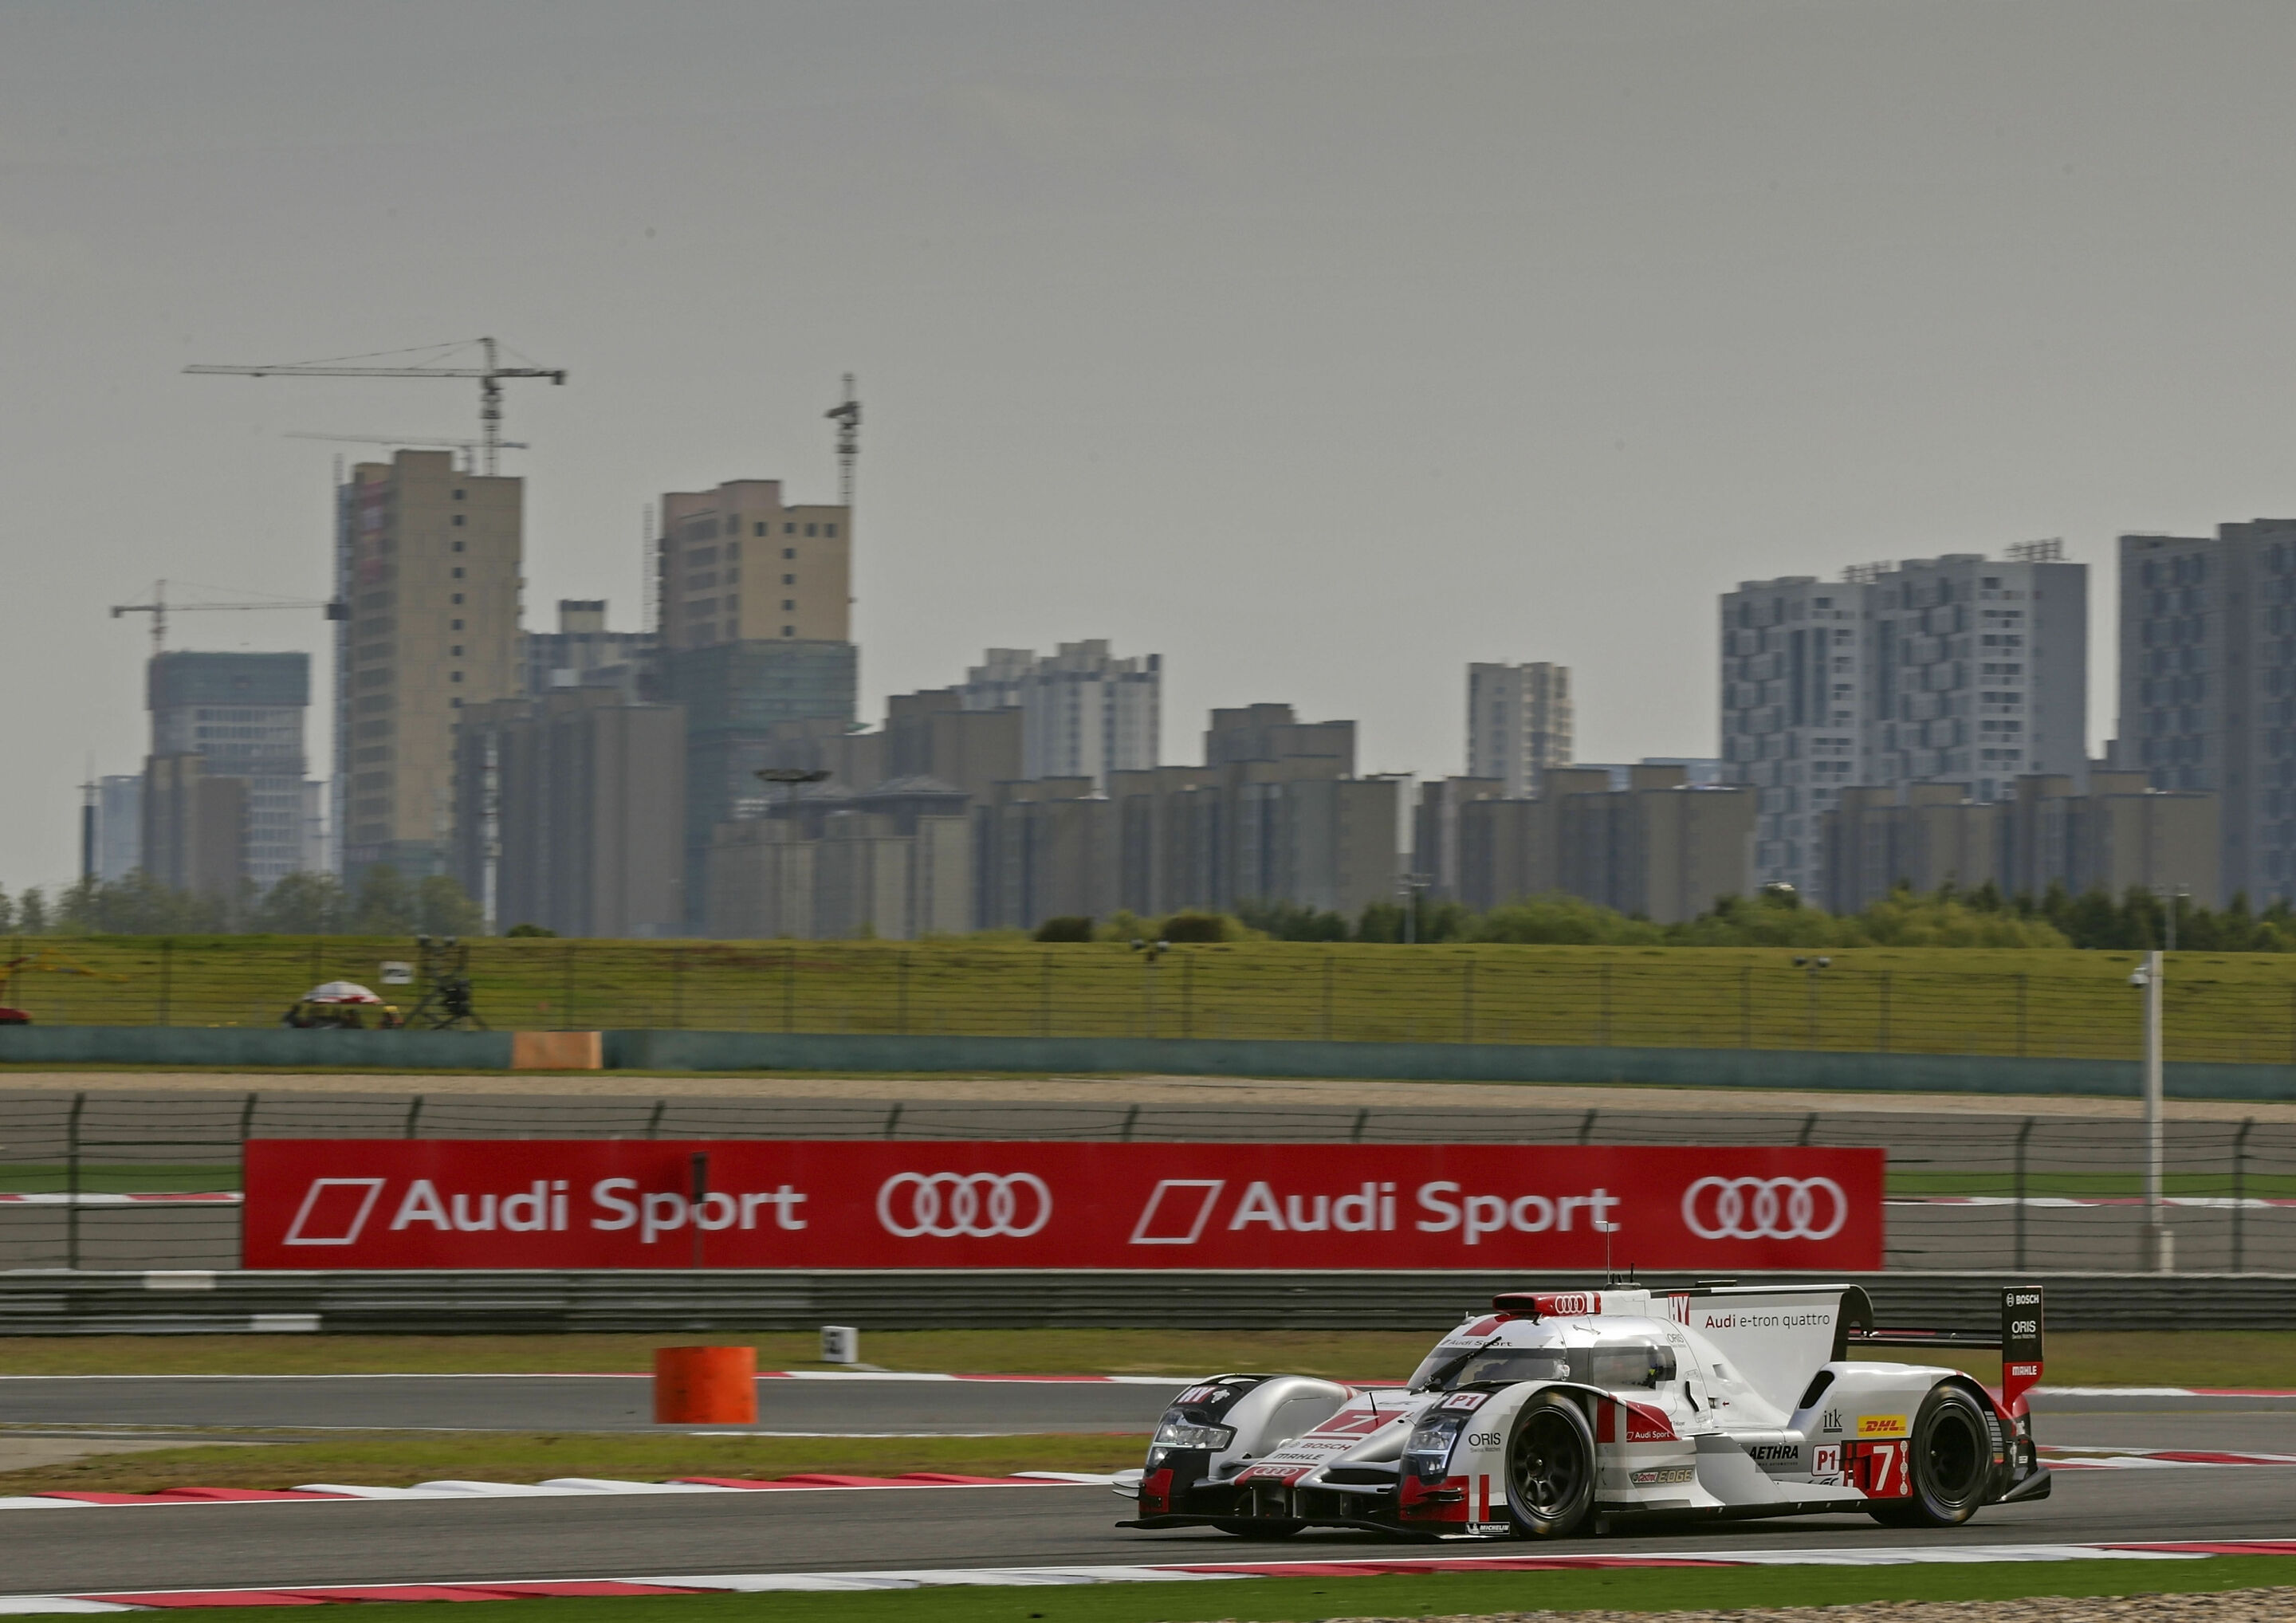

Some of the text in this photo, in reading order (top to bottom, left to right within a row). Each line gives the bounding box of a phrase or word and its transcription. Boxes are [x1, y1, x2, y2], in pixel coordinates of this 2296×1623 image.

[389, 1177, 808, 1244] Audi Sport
[1228, 1180, 1621, 1245] Audi Sport
[2015, 1294, 2039, 1305] BOSCH
[1705, 1314, 1830, 1329] Audi e-tron quattro
[2011, 1320, 2036, 1334] ORIS
[1667, 1333, 1685, 1344] ORIS
[2012, 1366, 2037, 1376] MAHLE
[1449, 1395, 1479, 1406] P1
[1332, 1415, 1380, 1432] 7
[1823, 1409, 1842, 1428] itk
[1866, 1421, 1899, 1432] DHL
[1468, 1432, 1501, 1447] ORIS
[1653, 1431, 1670, 1440] Sport
[1301, 1442, 1352, 1451] BOSCH
[1749, 1445, 1799, 1460] AETHRA
[1817, 1450, 1836, 1472] P1
[1873, 1445, 1894, 1491] 7
[1657, 1469, 1692, 1483] EDGE
